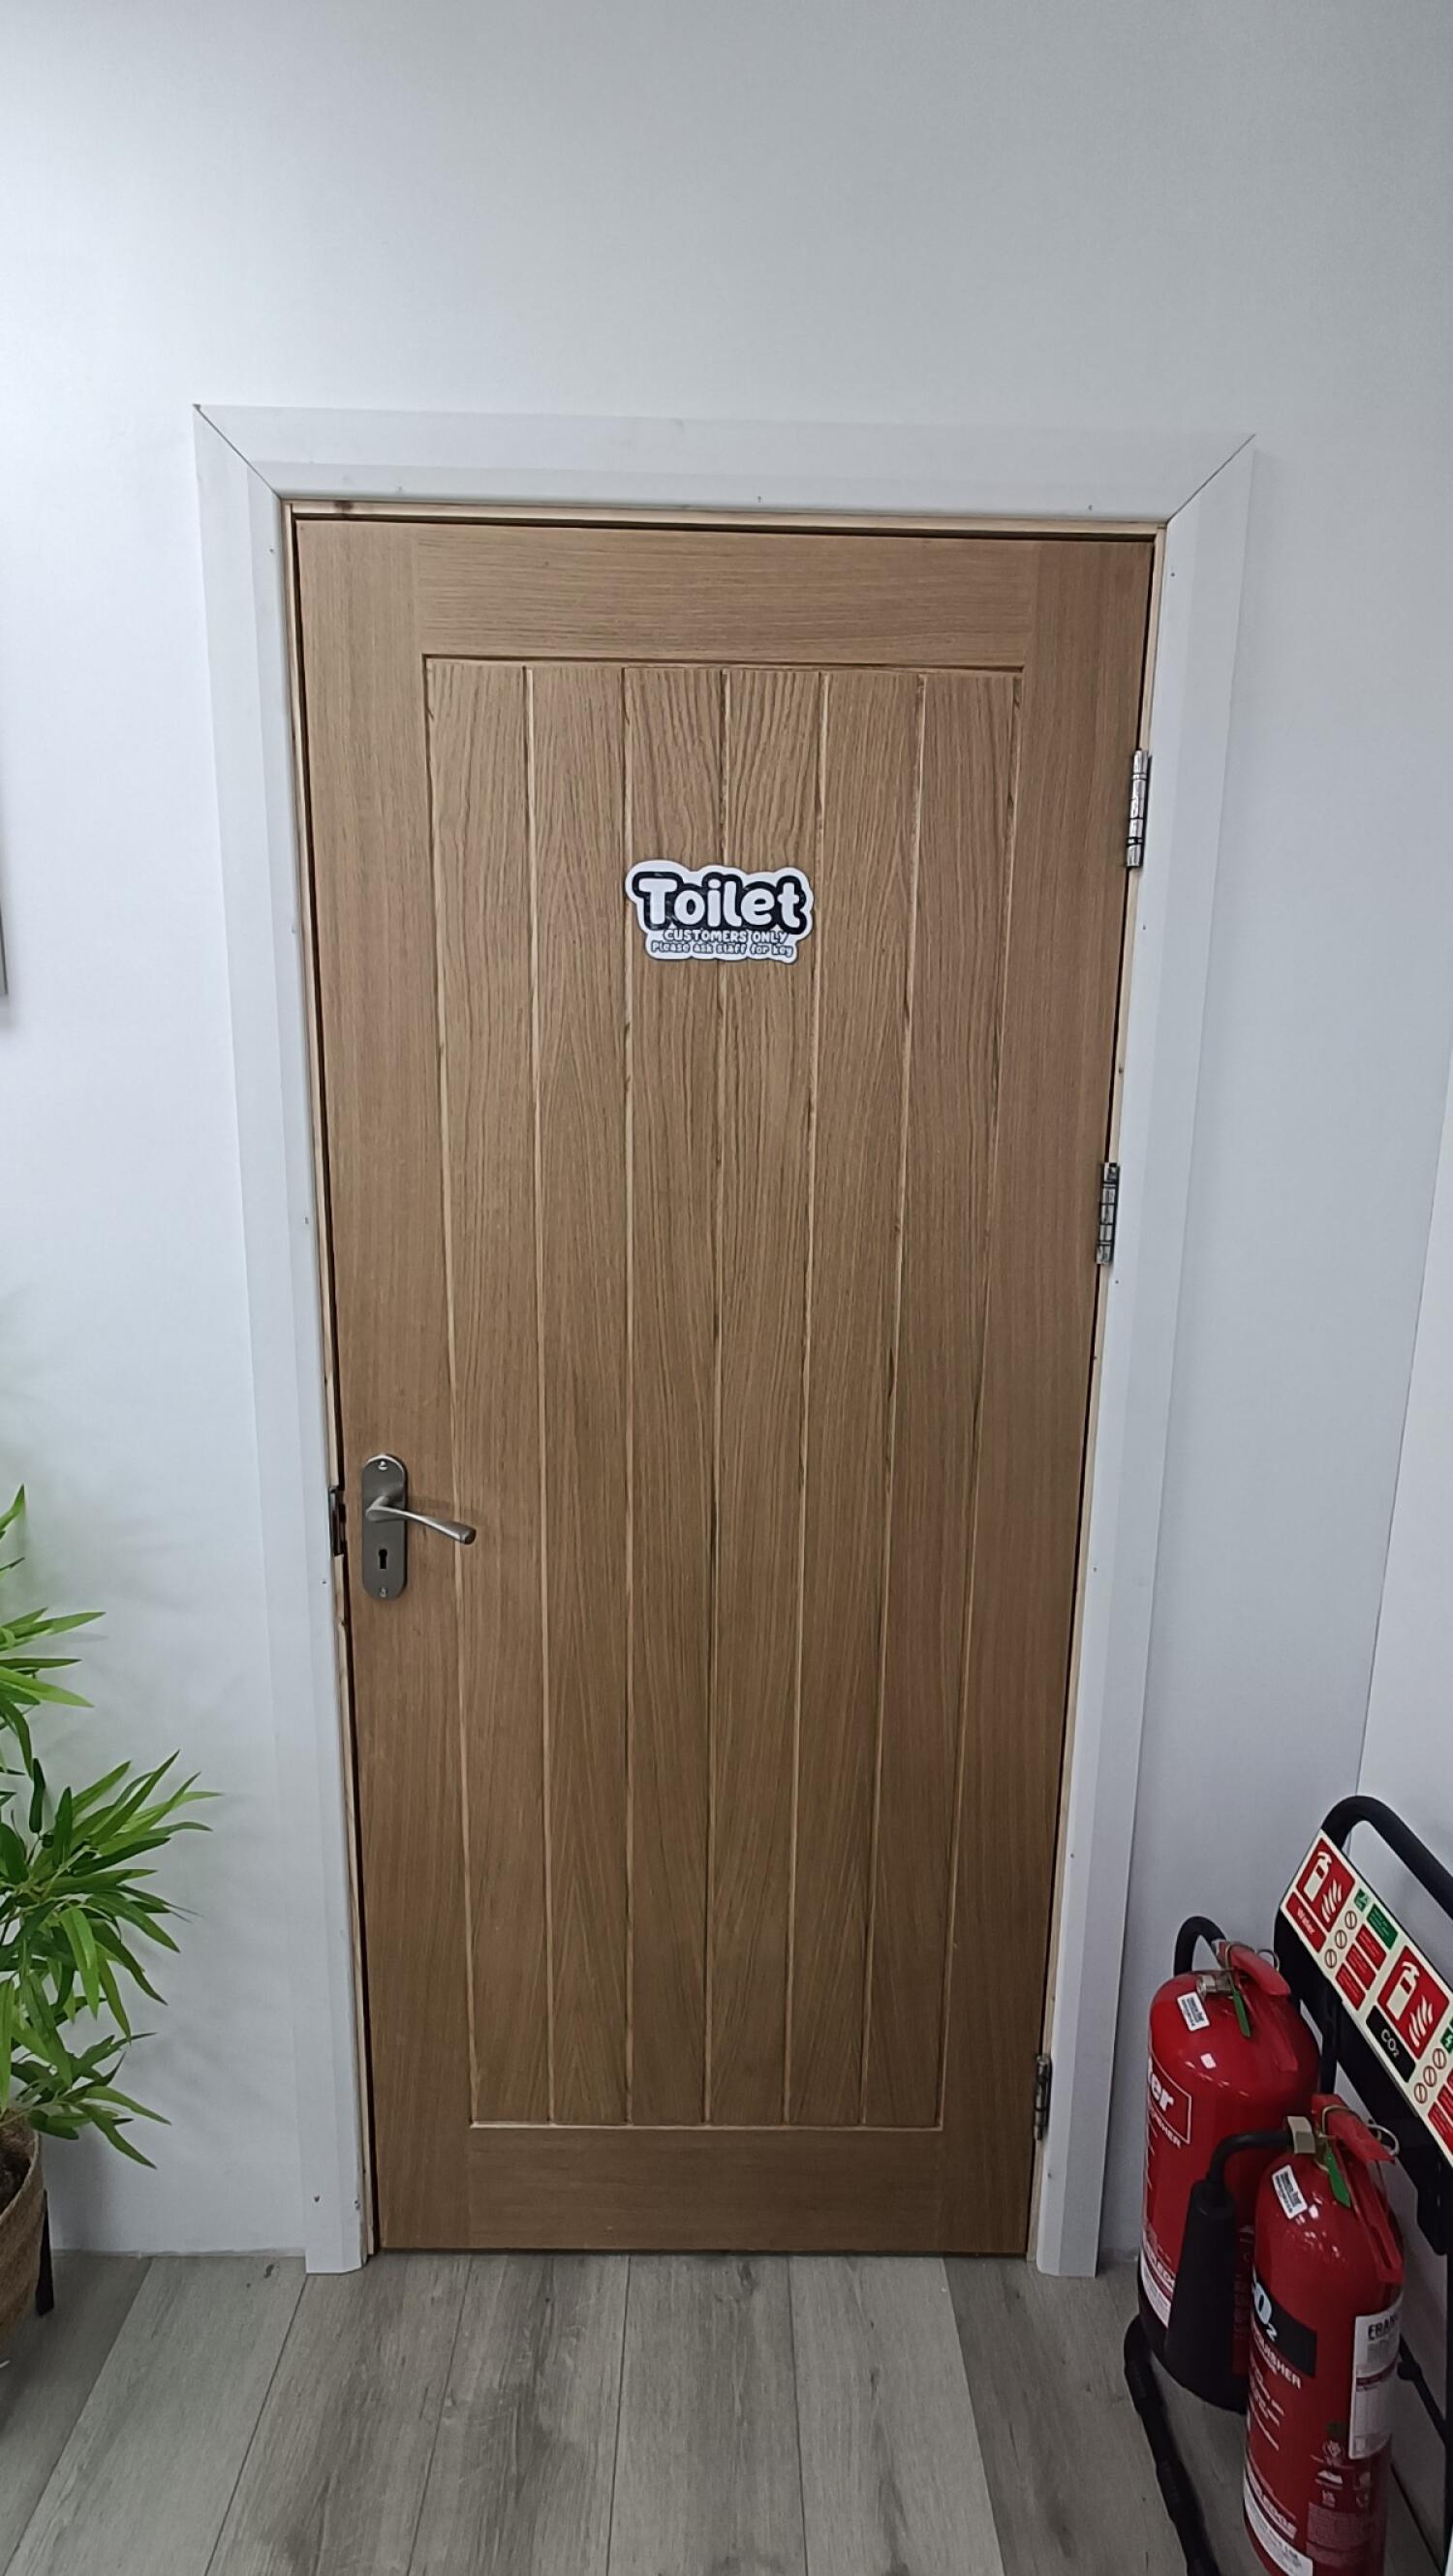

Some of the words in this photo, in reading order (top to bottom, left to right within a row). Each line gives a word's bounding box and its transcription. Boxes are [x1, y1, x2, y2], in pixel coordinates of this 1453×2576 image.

[635, 874, 804, 932] Toilet
[664, 929, 747, 943] CUSTOMERS
[751, 931, 788, 944] ONLY
[651, 941, 690, 953] Please
[716, 943, 747, 954] staff
[750, 943, 768, 954] for
[772, 944, 793, 957] key
